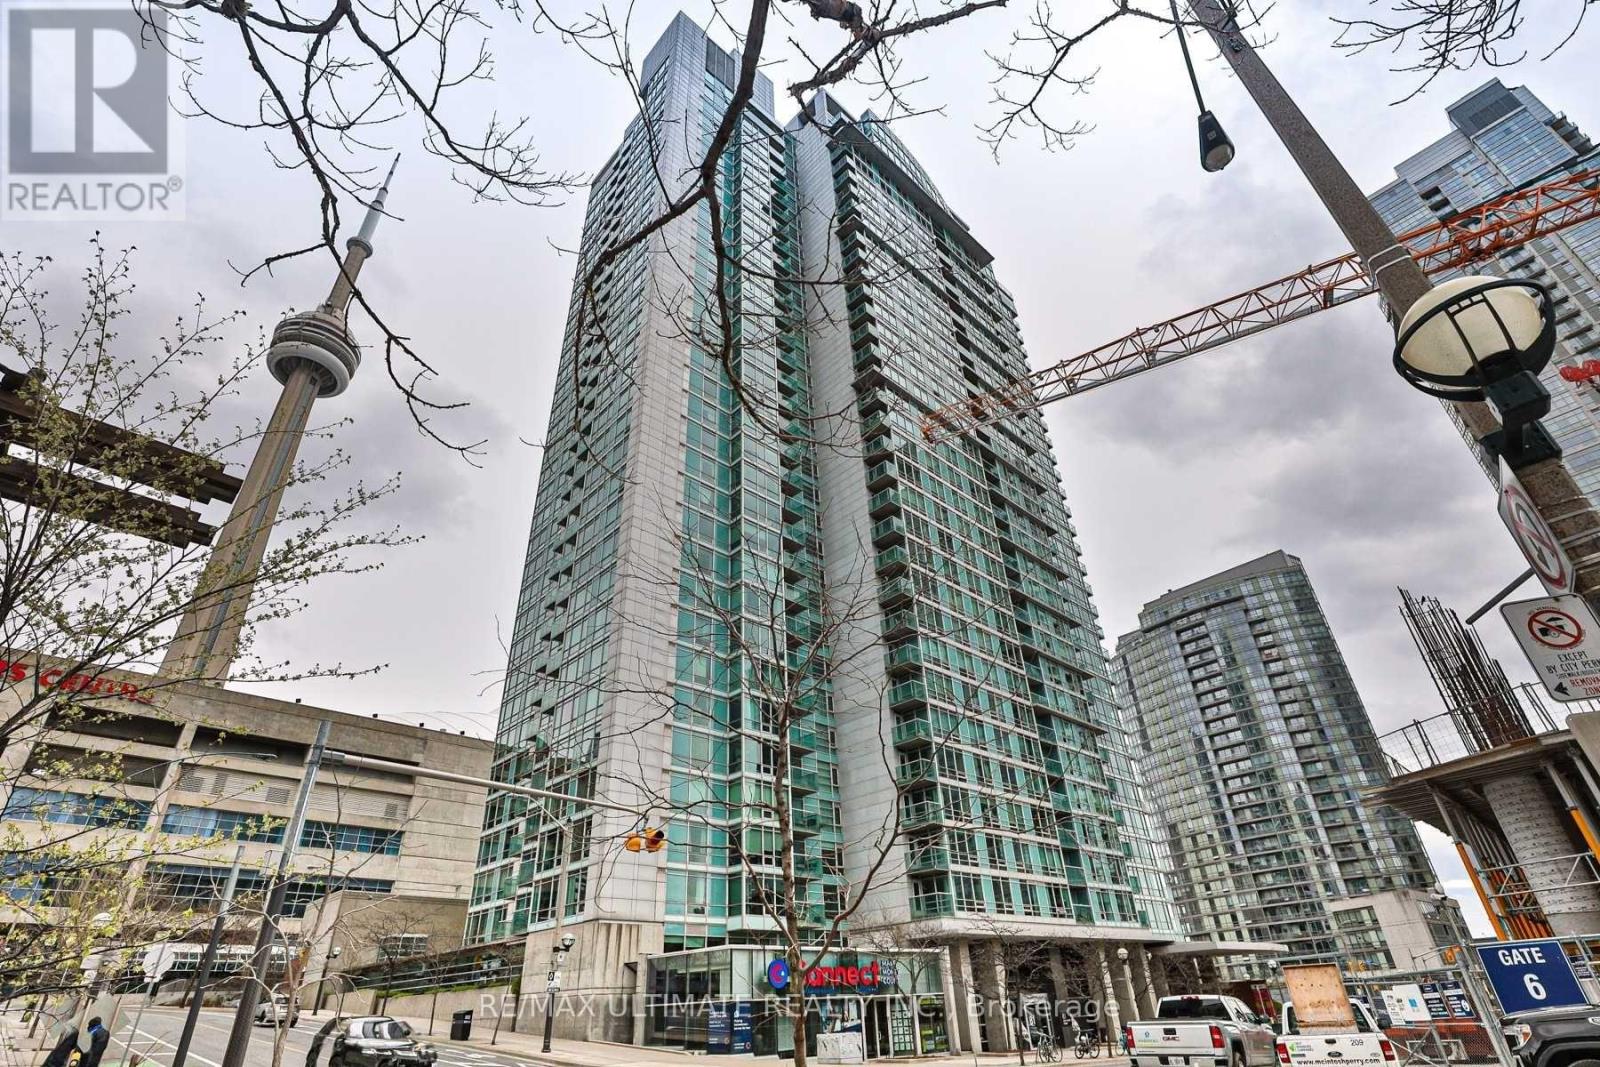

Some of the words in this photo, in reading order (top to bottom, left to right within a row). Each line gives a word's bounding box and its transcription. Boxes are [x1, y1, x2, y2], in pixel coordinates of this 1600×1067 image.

[1557, 650, 1588, 663] EXCEPT
[1546, 664, 1557, 674] BY
[1560, 661, 1579, 673] CITY
[1497, 947, 1546, 966] GATE
[798, 960, 879, 987] onnect
[1523, 973, 1547, 1000] 6
[1350, 1039, 1364, 1047] 209
[1296, 1057, 1381, 1066] www.mcintoshperry.com
